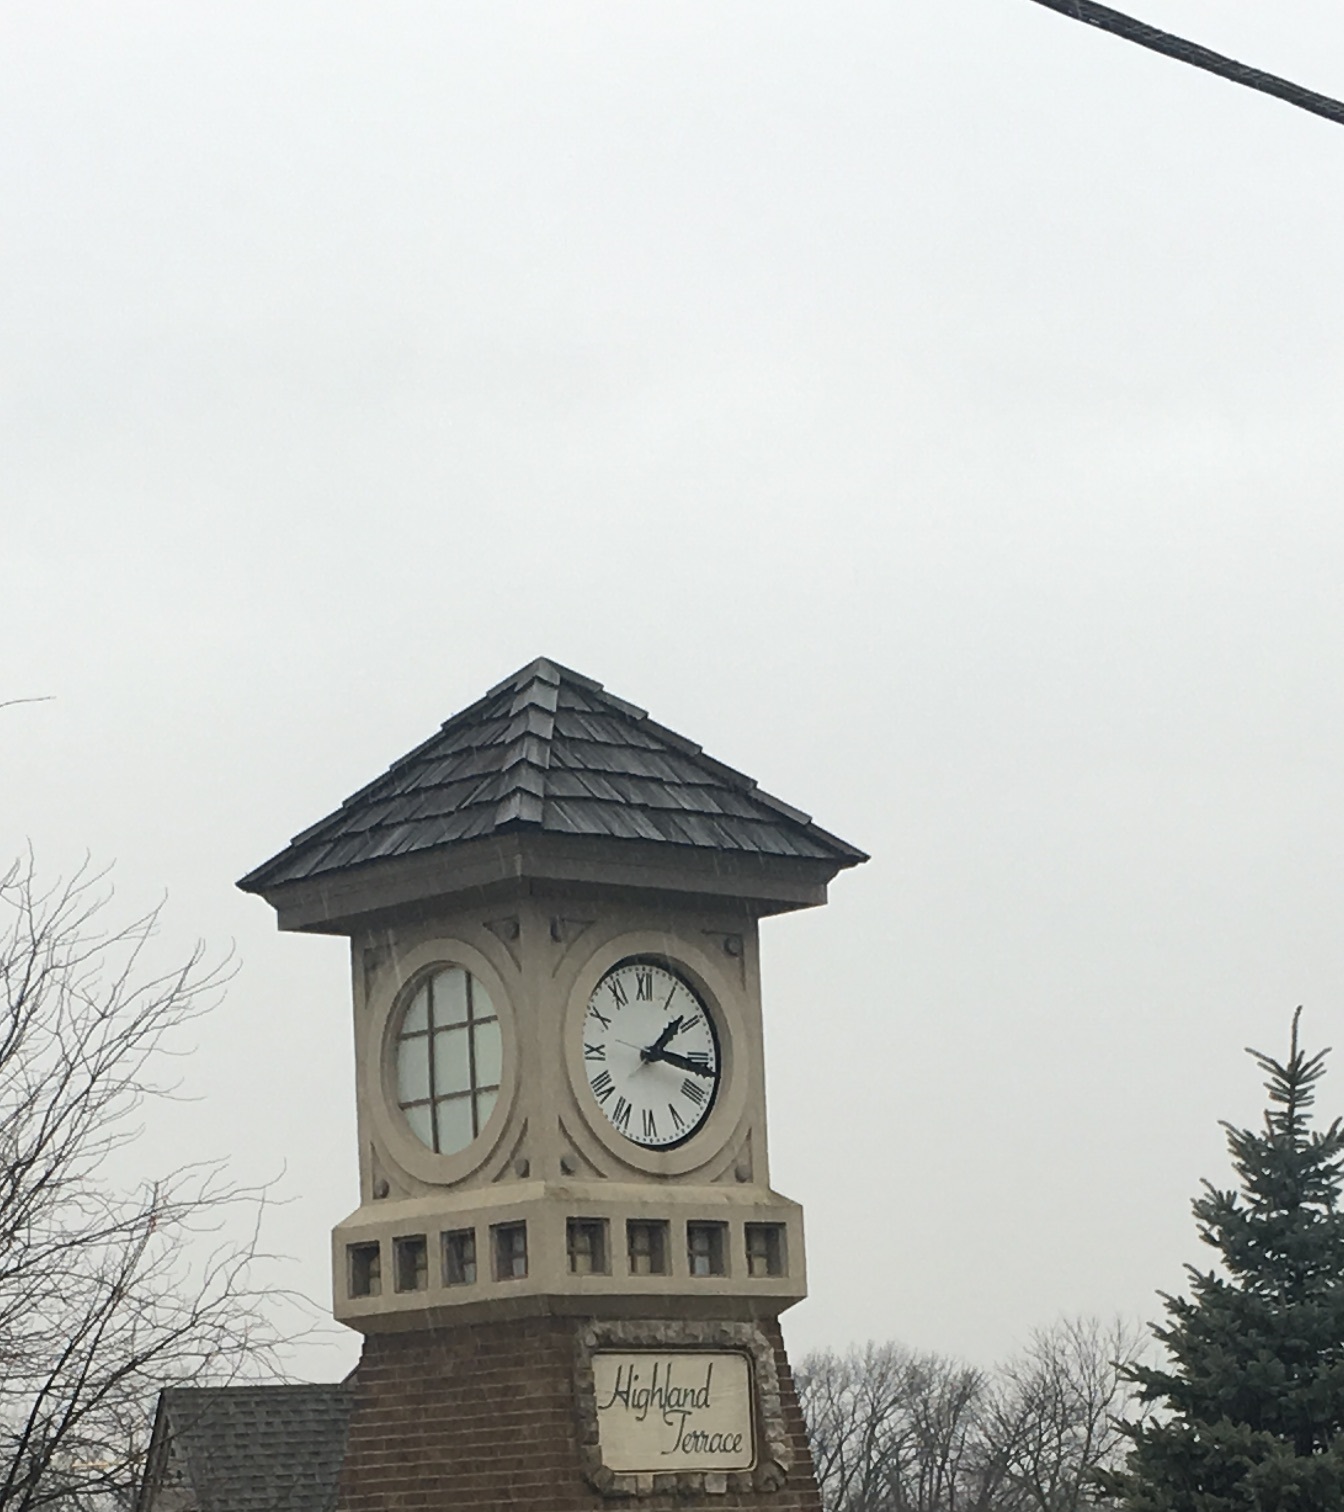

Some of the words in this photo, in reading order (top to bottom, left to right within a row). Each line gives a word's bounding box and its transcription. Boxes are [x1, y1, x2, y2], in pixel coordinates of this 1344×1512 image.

[607, 977, 629, 1011] XI
[635, 972, 653, 1001] XII
[589, 1005, 612, 1030] X
[680, 1014, 700, 1034] II
[584, 1043, 606, 1061] IX
[590, 1069, 616, 1105] VIII
[612, 1096, 632, 1130] VII
[642, 1109, 657, 1138] VI
[668, 1103, 685, 1130] V
[598, 1362, 713, 1426] Highland
[660, 1409, 743, 1455] Terrace
